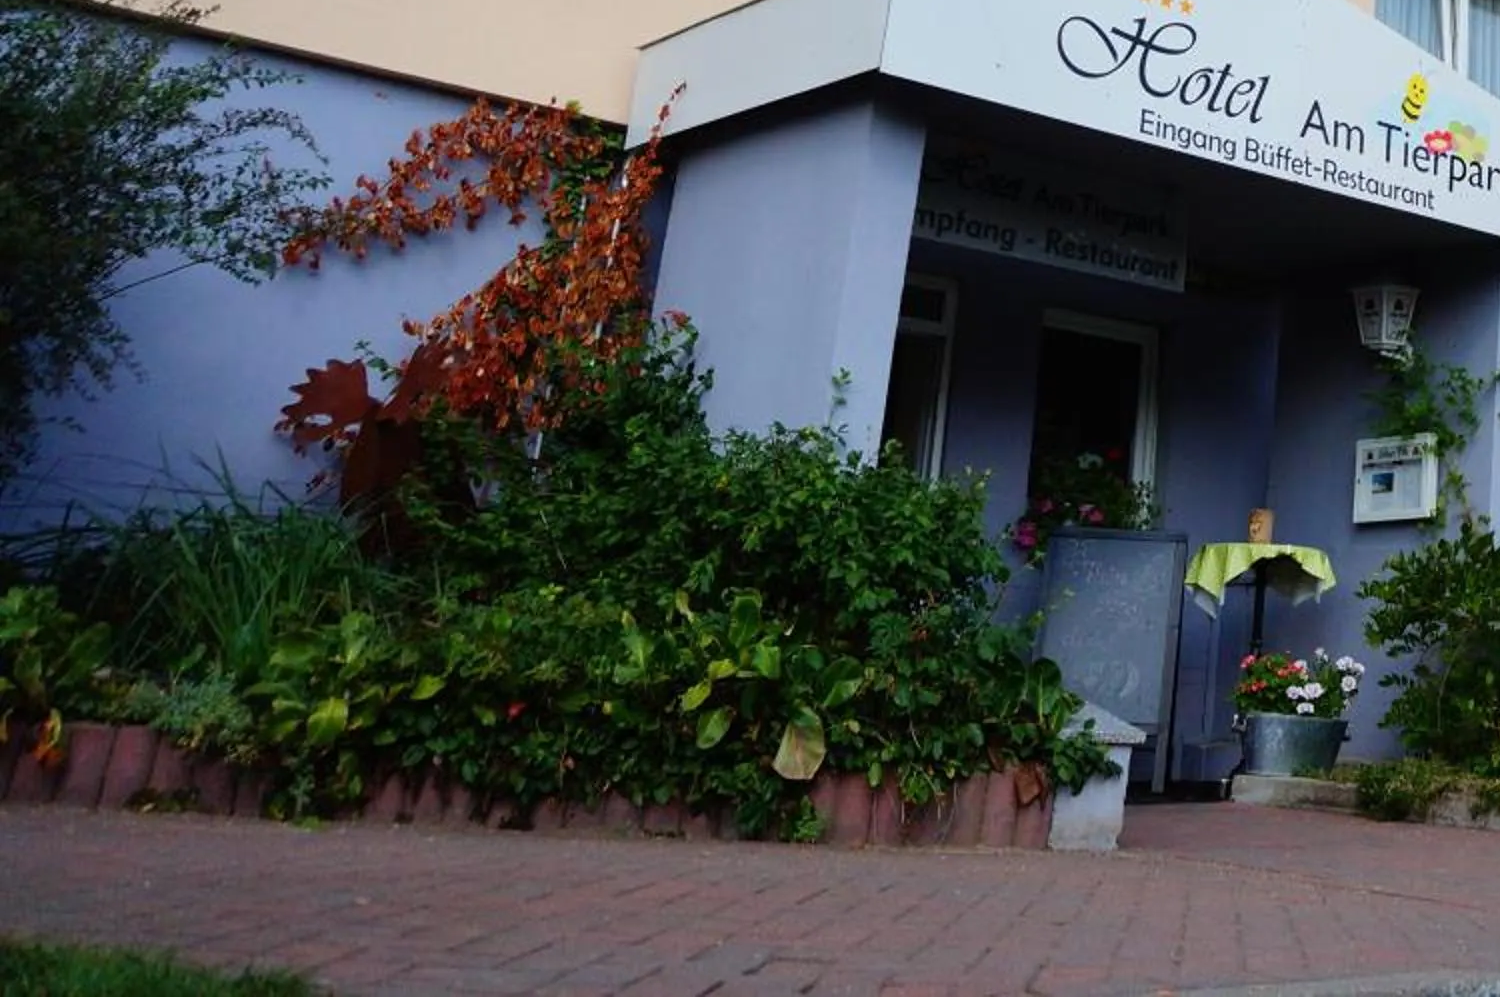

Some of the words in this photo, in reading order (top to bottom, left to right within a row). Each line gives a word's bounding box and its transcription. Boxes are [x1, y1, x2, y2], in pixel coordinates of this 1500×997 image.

[1057, 16, 1271, 124] Hotel
[1299, 99, 1365, 155] Am
[1139, 108, 1237, 161] Eingang
[1244, 137, 1435, 211] Büffet-Restaurant
[915, 208, 1017, 252] mpfang
[1044, 227, 1179, 280] Restaurant
